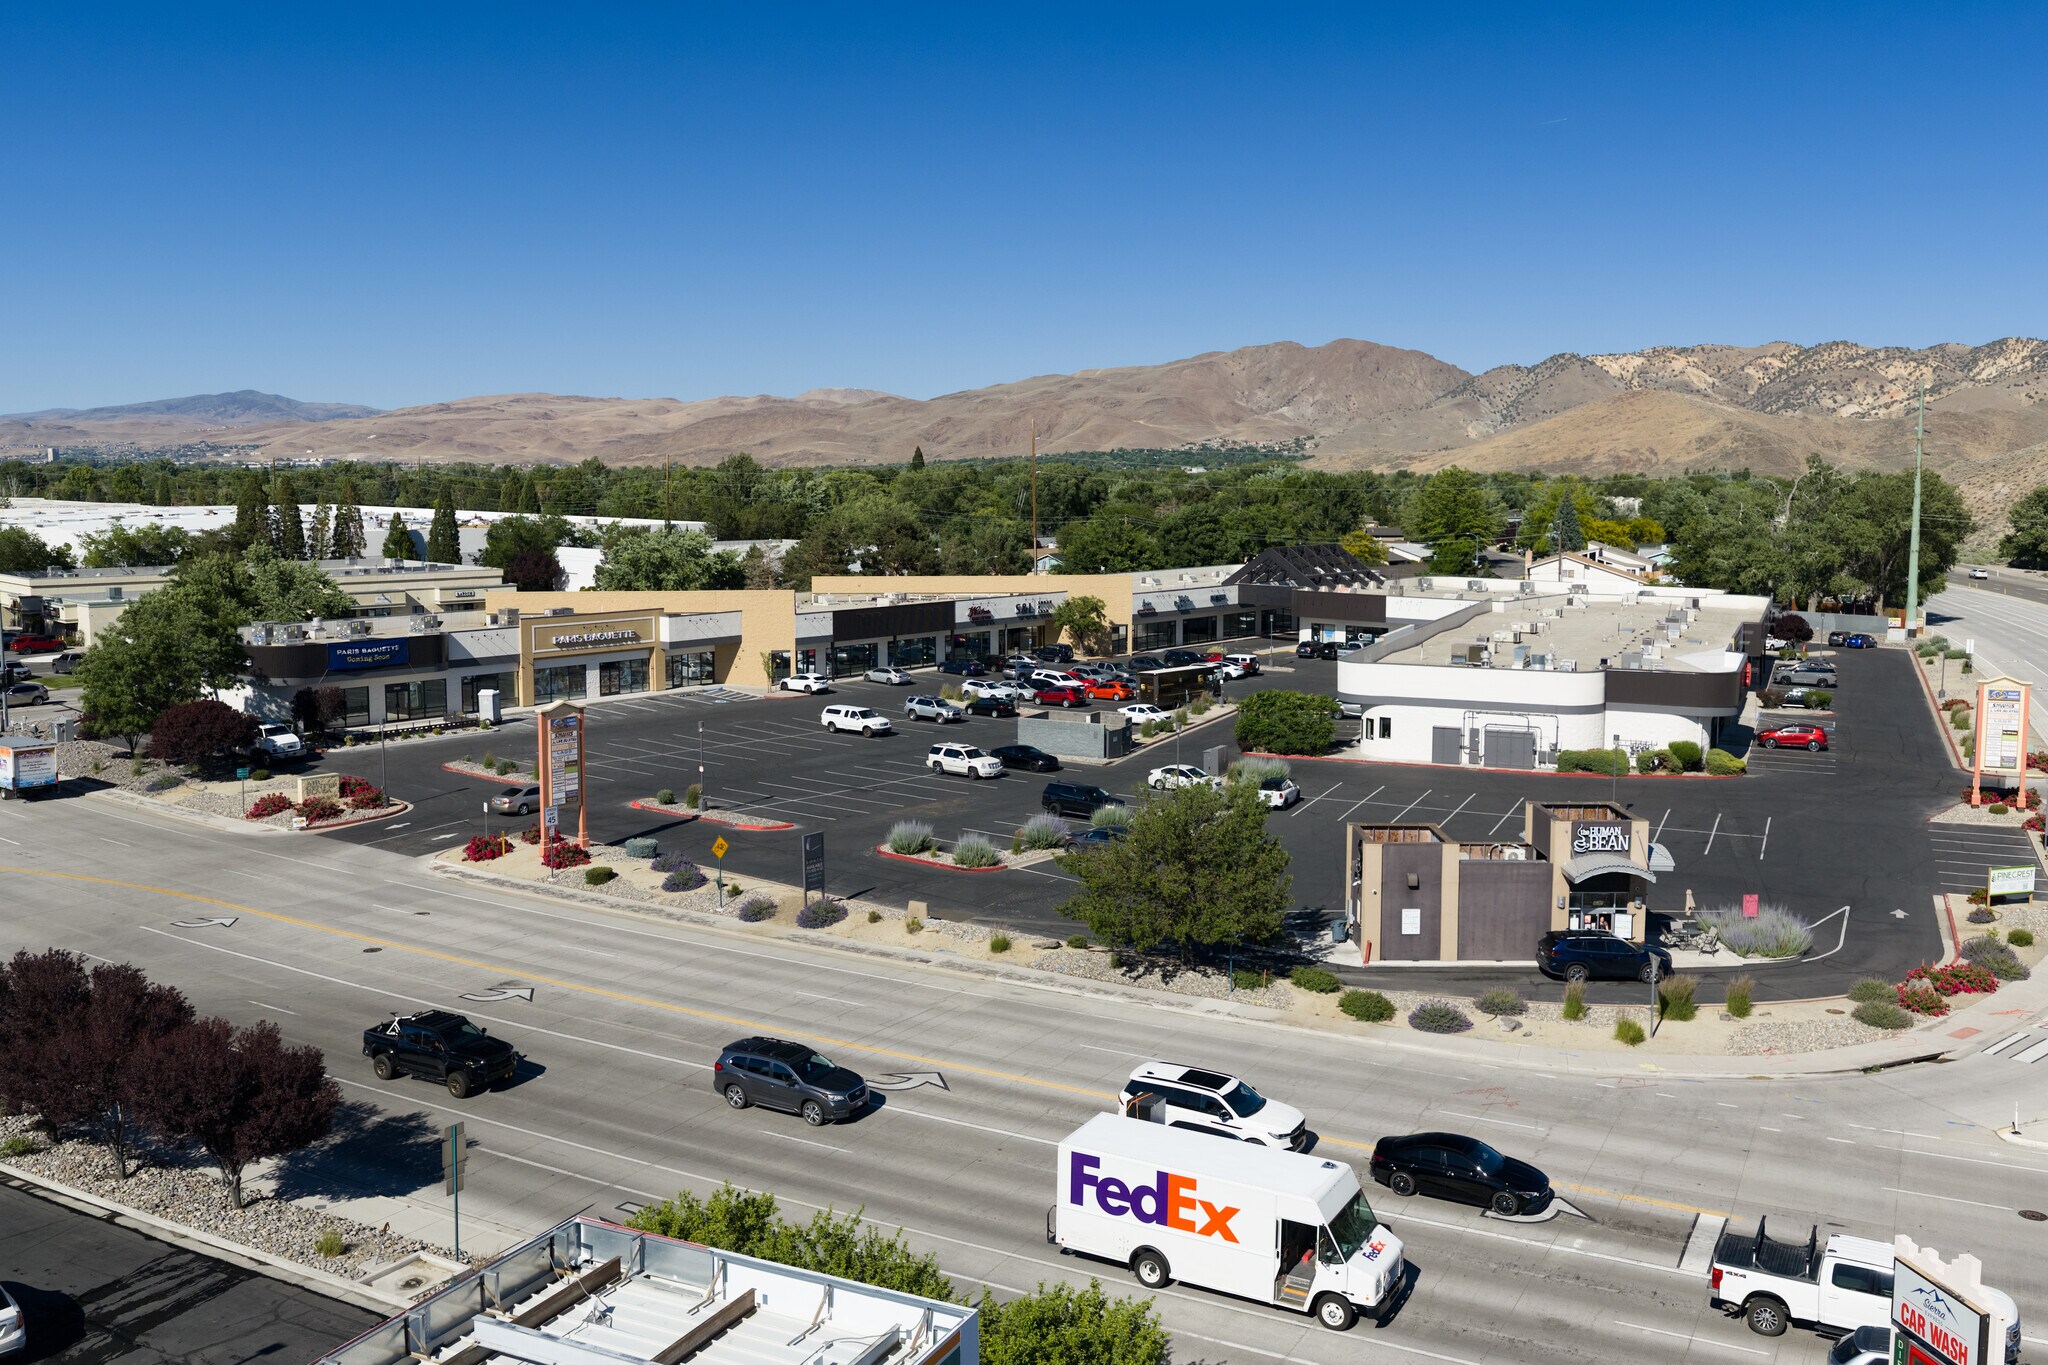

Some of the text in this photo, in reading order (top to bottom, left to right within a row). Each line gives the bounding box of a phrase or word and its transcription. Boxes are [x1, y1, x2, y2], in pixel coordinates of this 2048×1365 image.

[552, 629, 636, 644] PARIS BAGUETTE
[336, 644, 400, 655] PARIS BAGUETTE
[1589, 826, 1622, 836] HUMAN
[1588, 835, 1630, 850] BEAN
[1997, 870, 2034, 879] PINECREST
[1070, 1151, 1241, 1244] FedEx
[1362, 1240, 1386, 1262] FedEx
[1922, 1298, 1947, 1321] Sierra
[1901, 1302, 1968, 1365] CAR WASH
